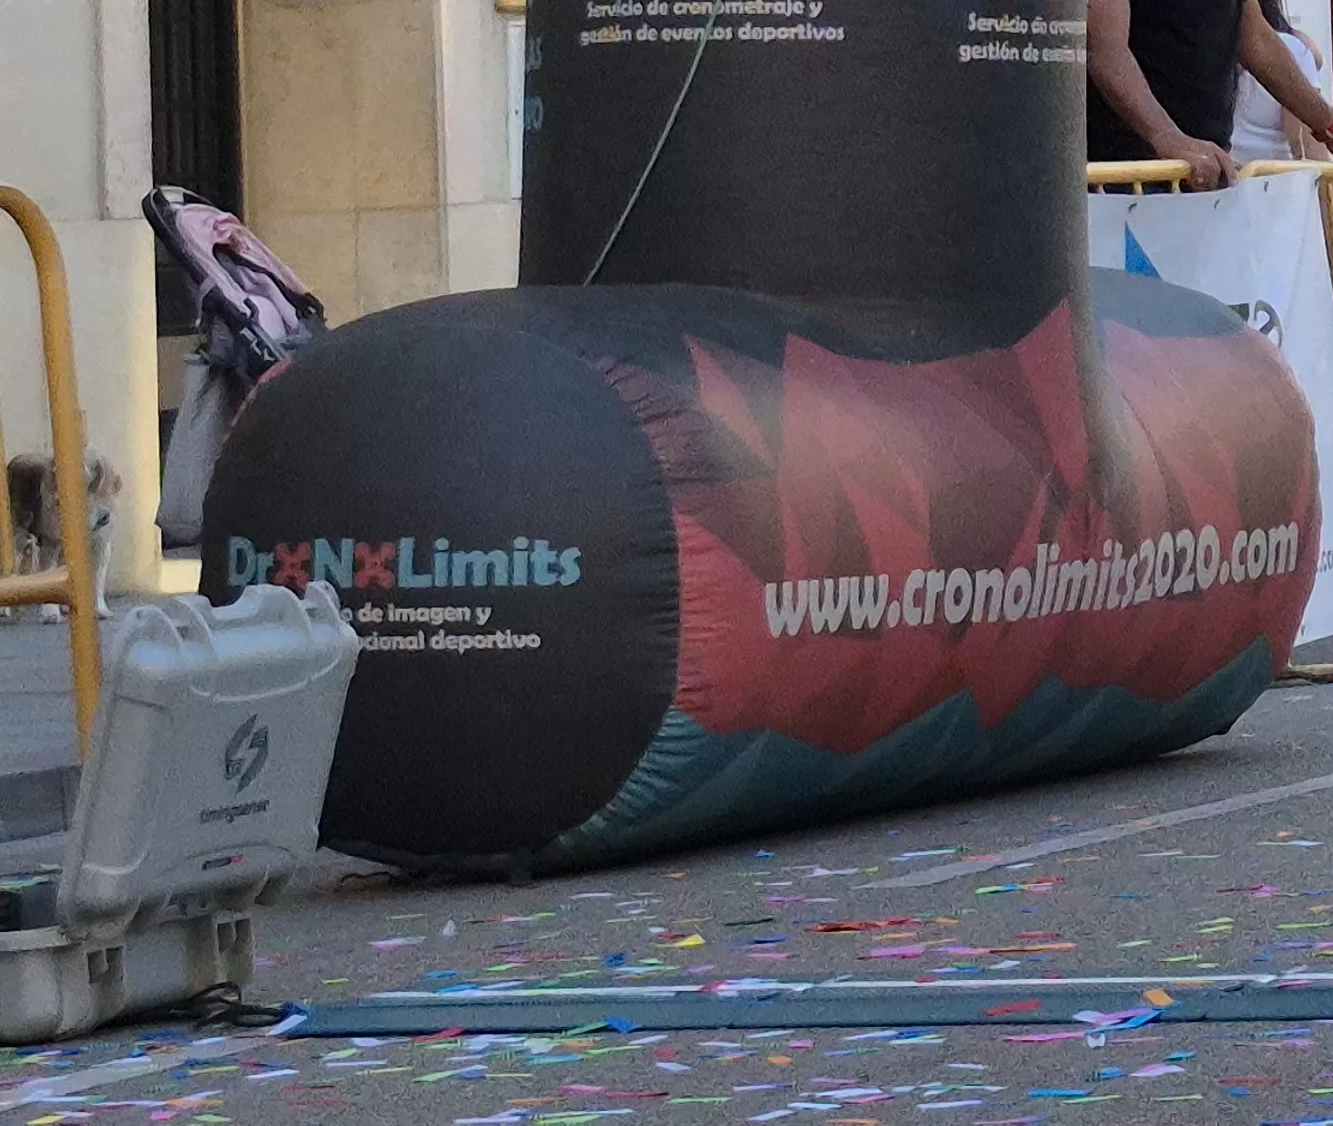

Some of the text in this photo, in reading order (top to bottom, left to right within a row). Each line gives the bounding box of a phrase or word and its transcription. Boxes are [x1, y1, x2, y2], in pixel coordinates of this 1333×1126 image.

[808, 0, 824, 18] y
[636, 23, 659, 42] de
[737, 22, 846, 43] deportivos
[958, 41, 1020, 64] gestión
[764, 521, 1300, 638] www.cronolimits2020.com
[356, 601, 383, 623] de
[388, 603, 471, 627] imagen
[474, 606, 492, 627] y
[429, 629, 541, 656] deportivo
